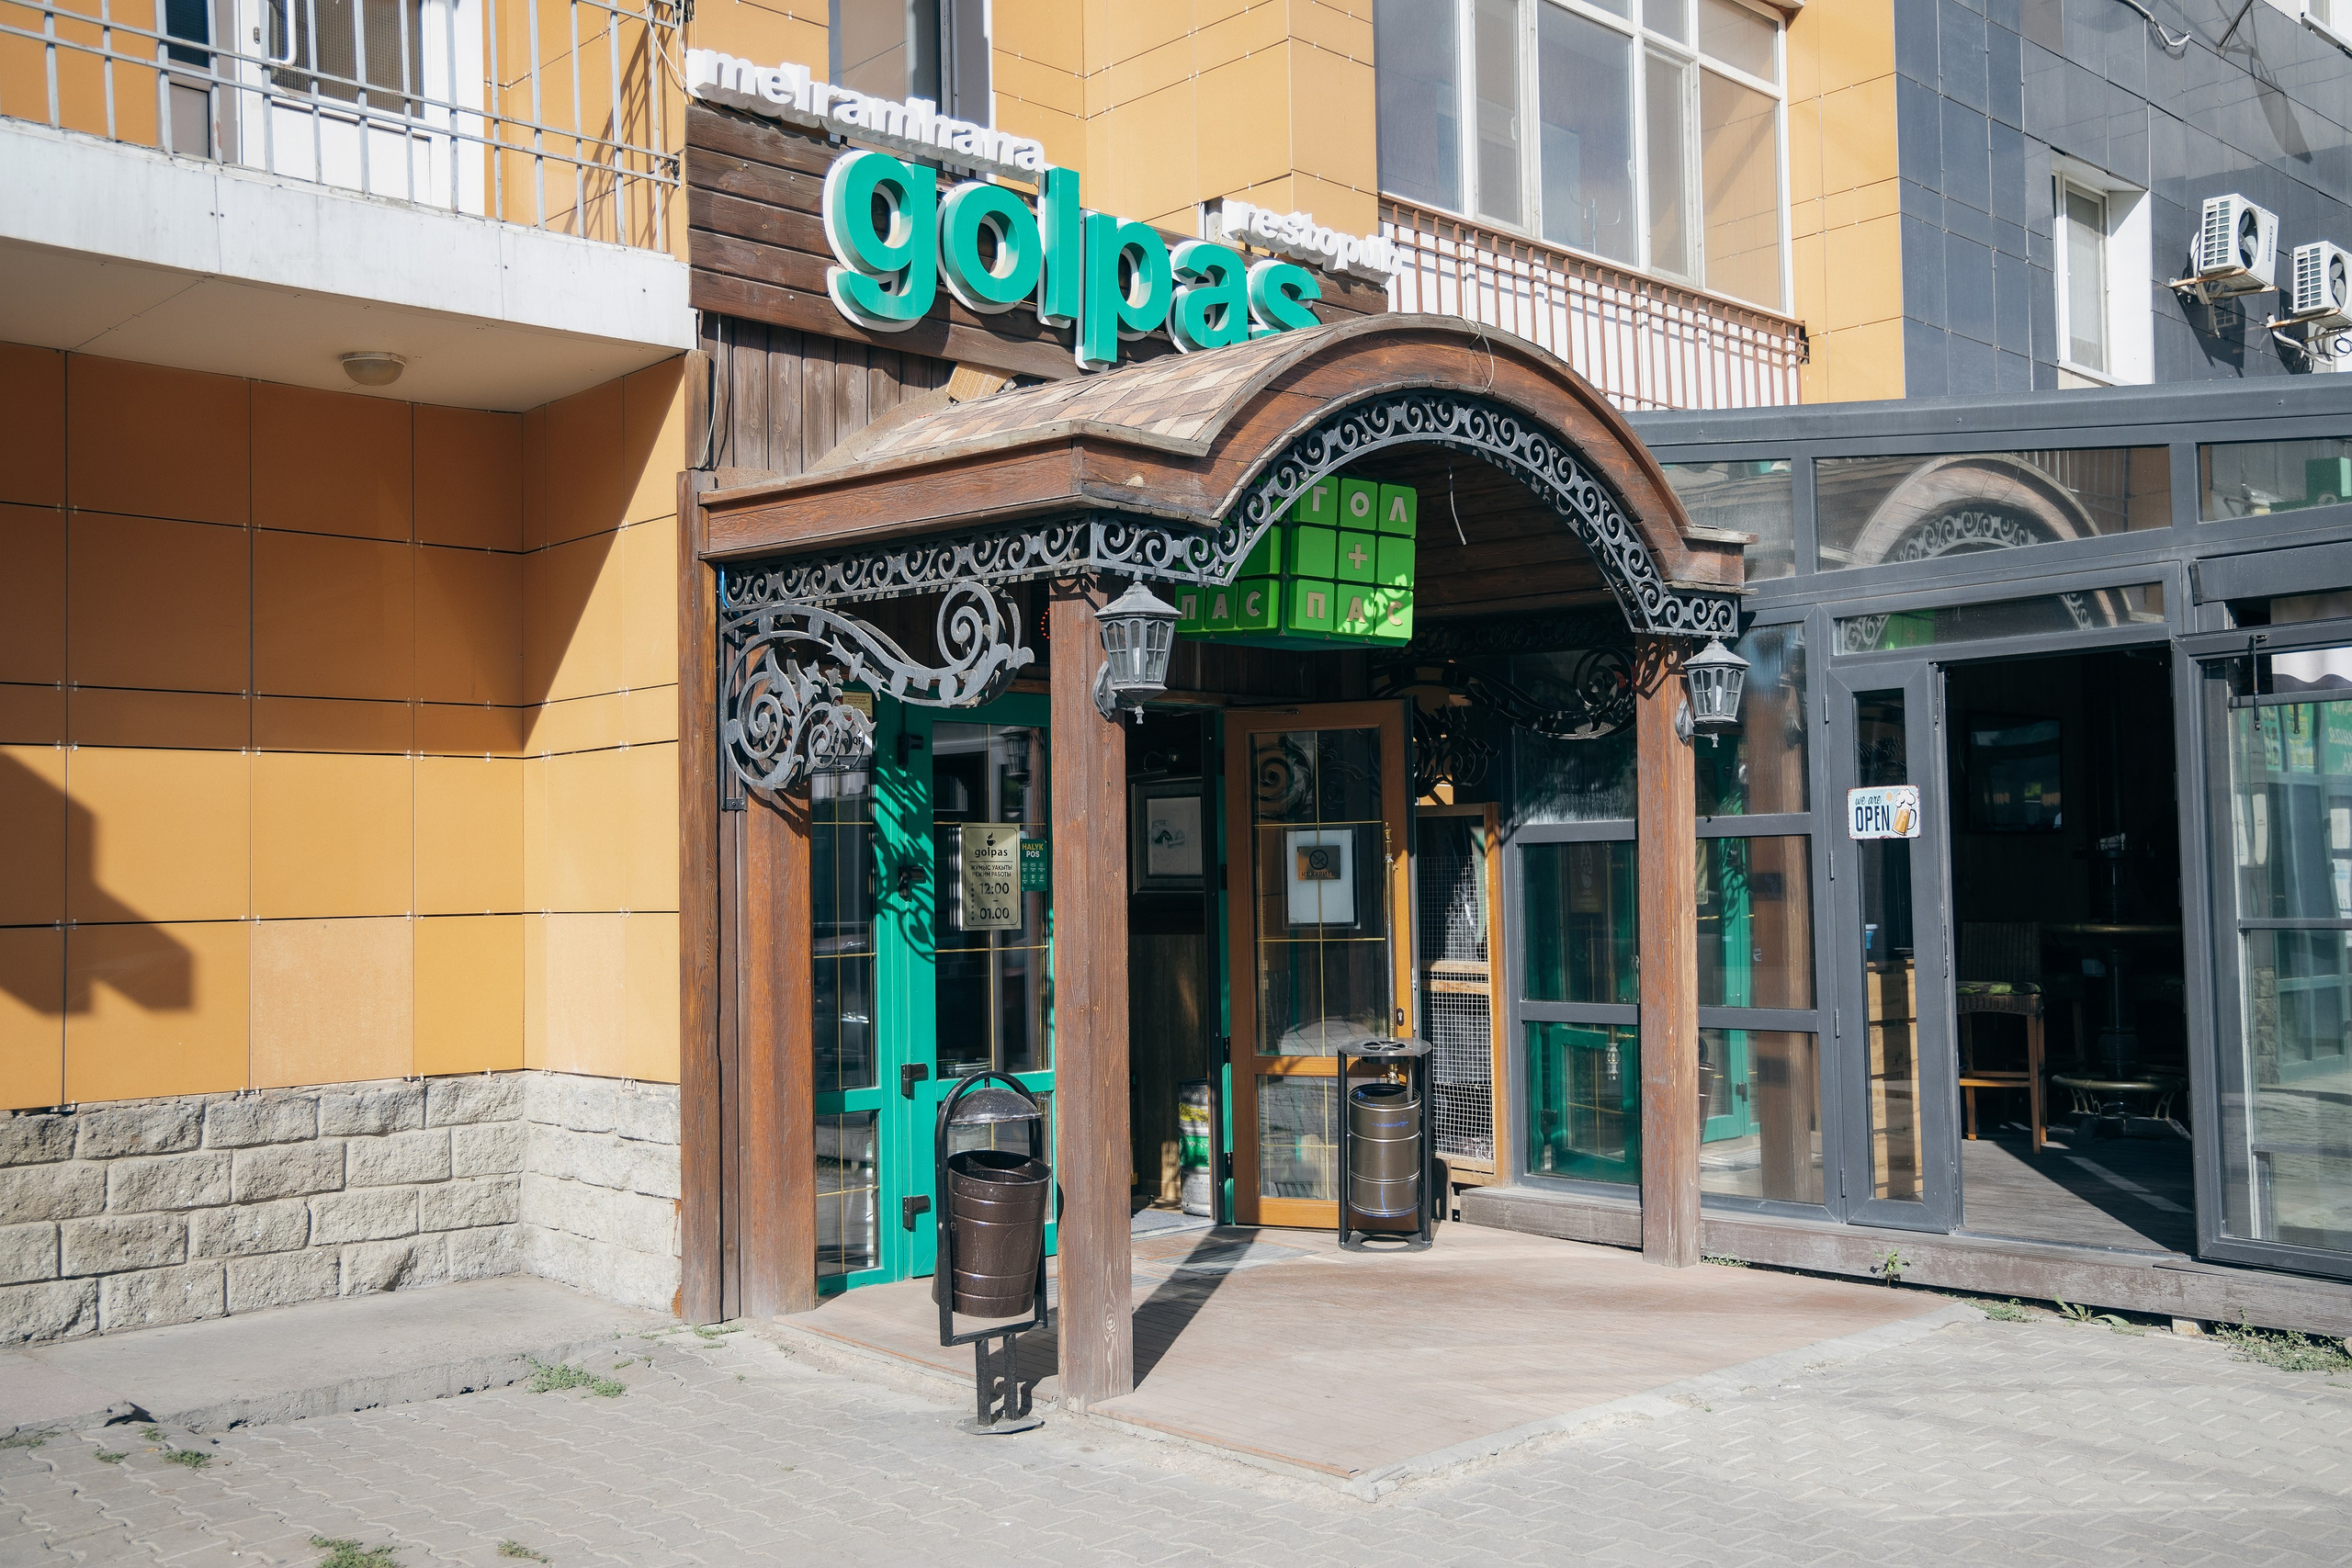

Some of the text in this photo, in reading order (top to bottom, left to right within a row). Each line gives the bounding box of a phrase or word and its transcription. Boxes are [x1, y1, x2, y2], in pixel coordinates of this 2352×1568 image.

[1222, 199, 1403, 283] restopub
[823, 150, 1322, 372] golpas
[1312, 485, 1408, 523] ГОЛ
[1182, 591, 1261, 620] ПАС
[1306, 592, 1404, 626] ПАС
[1855, 795, 1882, 806] we are
[1856, 805, 1890, 832] OPEN
[975, 847, 1008, 858] golpas
[1022, 842, 1044, 851] HALYK
[979, 882, 1010, 895] 12:00
[979, 907, 1010, 919] 01.00
